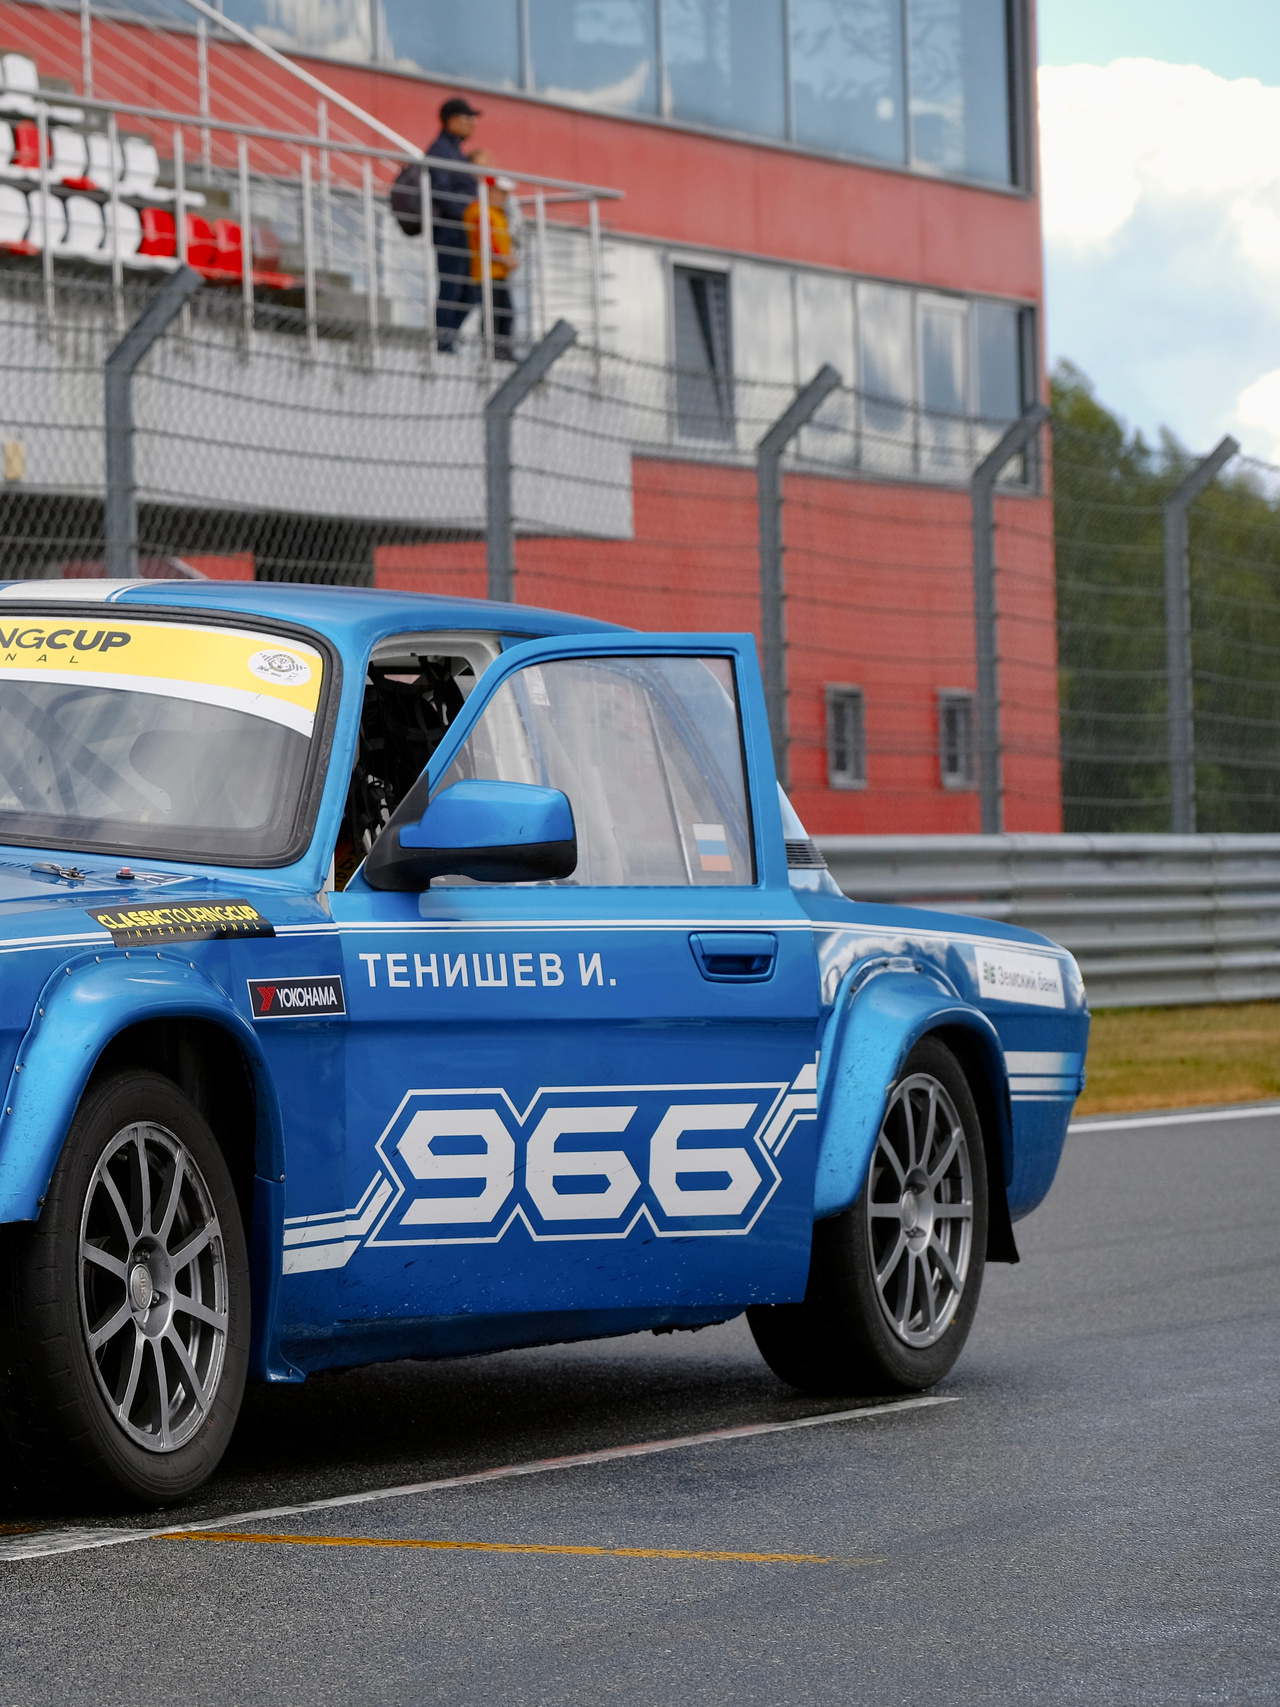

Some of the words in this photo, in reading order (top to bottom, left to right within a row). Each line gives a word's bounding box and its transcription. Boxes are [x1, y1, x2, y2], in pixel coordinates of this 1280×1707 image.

[97, 905, 260, 930] CLASSICTOURINGCUP
[126, 922, 260, 939] INTERNATIONAL
[359, 952, 565, 987] ТЕНИШЕВ
[578, 952, 617, 986] И.
[997, 966, 1037, 990] Земский
[1038, 971, 1059, 993] банк
[276, 986, 338, 1009] YOKOHAMA
[396, 1103, 763, 1225] 966
